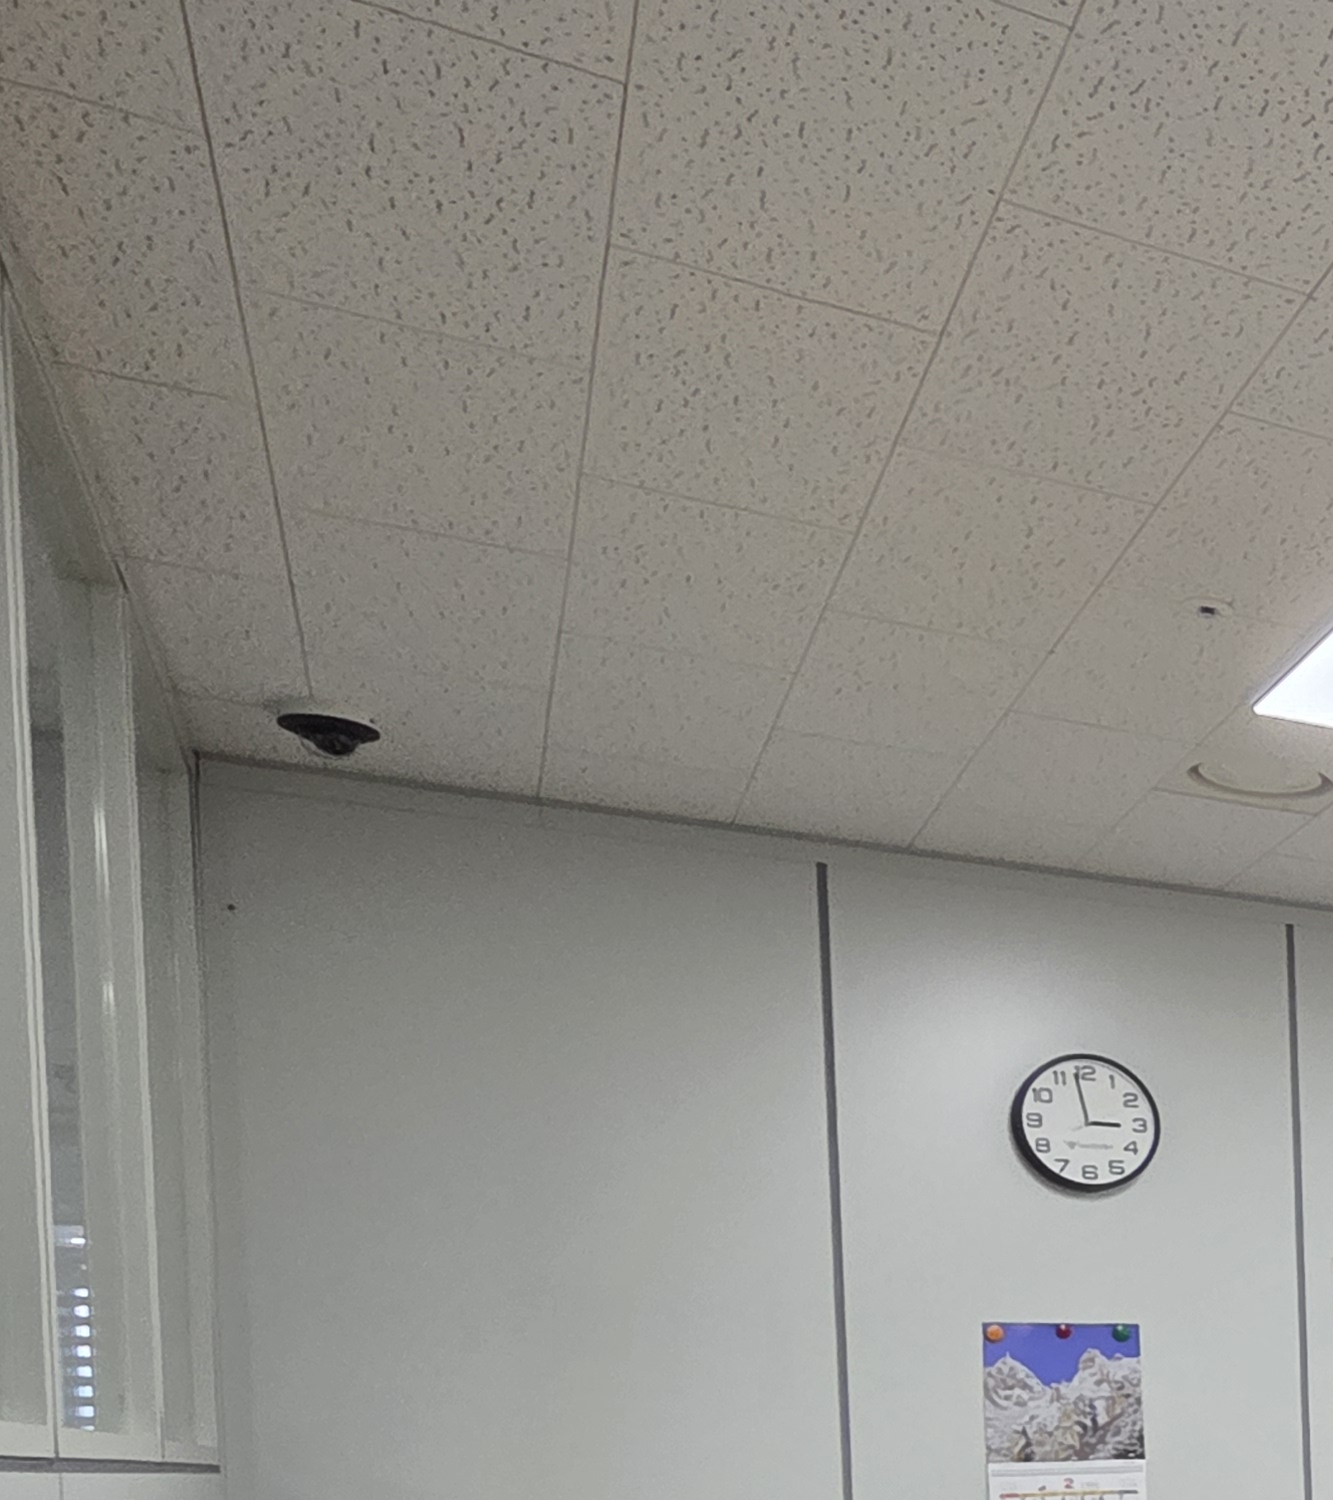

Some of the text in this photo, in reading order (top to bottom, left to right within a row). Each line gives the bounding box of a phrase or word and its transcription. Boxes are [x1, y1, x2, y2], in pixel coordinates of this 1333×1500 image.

[1052, 1070, 1067, 1086] 11
[1074, 1065, 1097, 1082] 12
[1109, 1074, 1116, 1090] 1
[1032, 1087, 1053, 1103] 10
[1122, 1092, 1139, 1108] 2
[1026, 1112, 1043, 1128] 9
[1132, 1117, 1148, 1133] 3
[1035, 1137, 1051, 1153] 8
[1123, 1140, 1139, 1155] 4
[1054, 1158, 1070, 1173] 7
[1081, 1165, 1098, 1180] 6
[1108, 1160, 1125, 1175] 5
